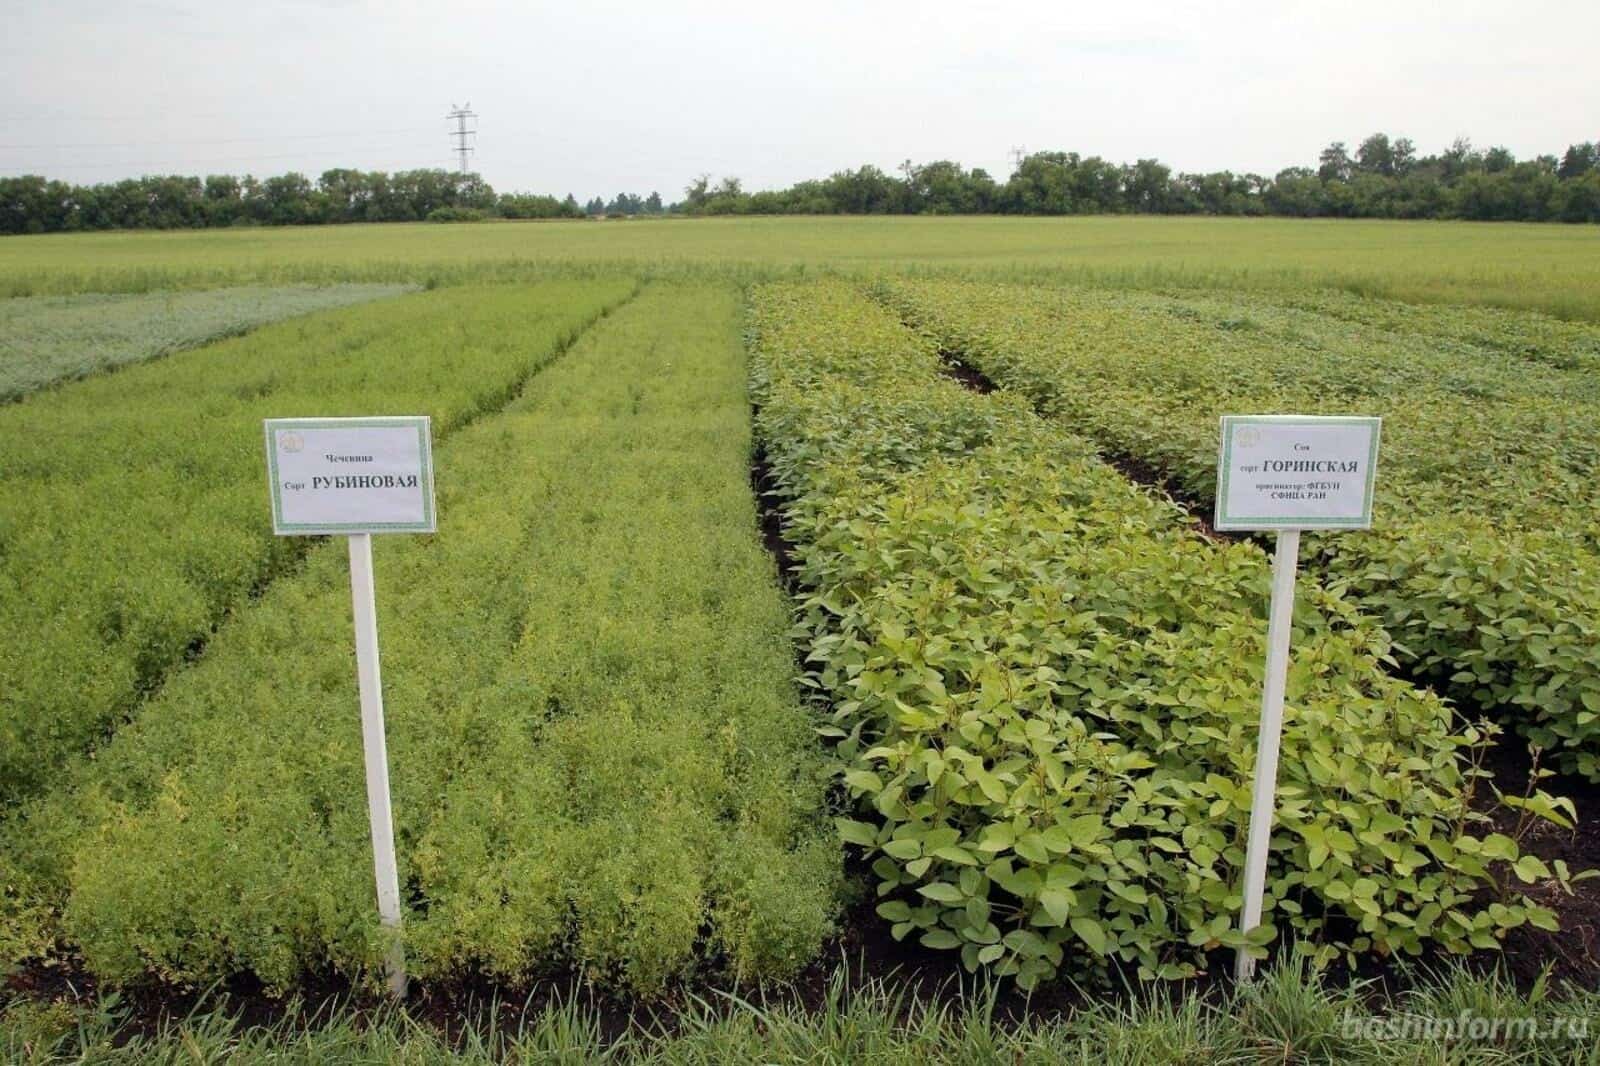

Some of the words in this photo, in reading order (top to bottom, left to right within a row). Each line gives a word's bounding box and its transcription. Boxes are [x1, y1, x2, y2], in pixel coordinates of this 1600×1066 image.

[1263, 460, 1358, 473] ГОРИНСКАЯ
[285, 481, 305, 491] Сорт
[312, 475, 417, 489] РУБИНОВАЯ
